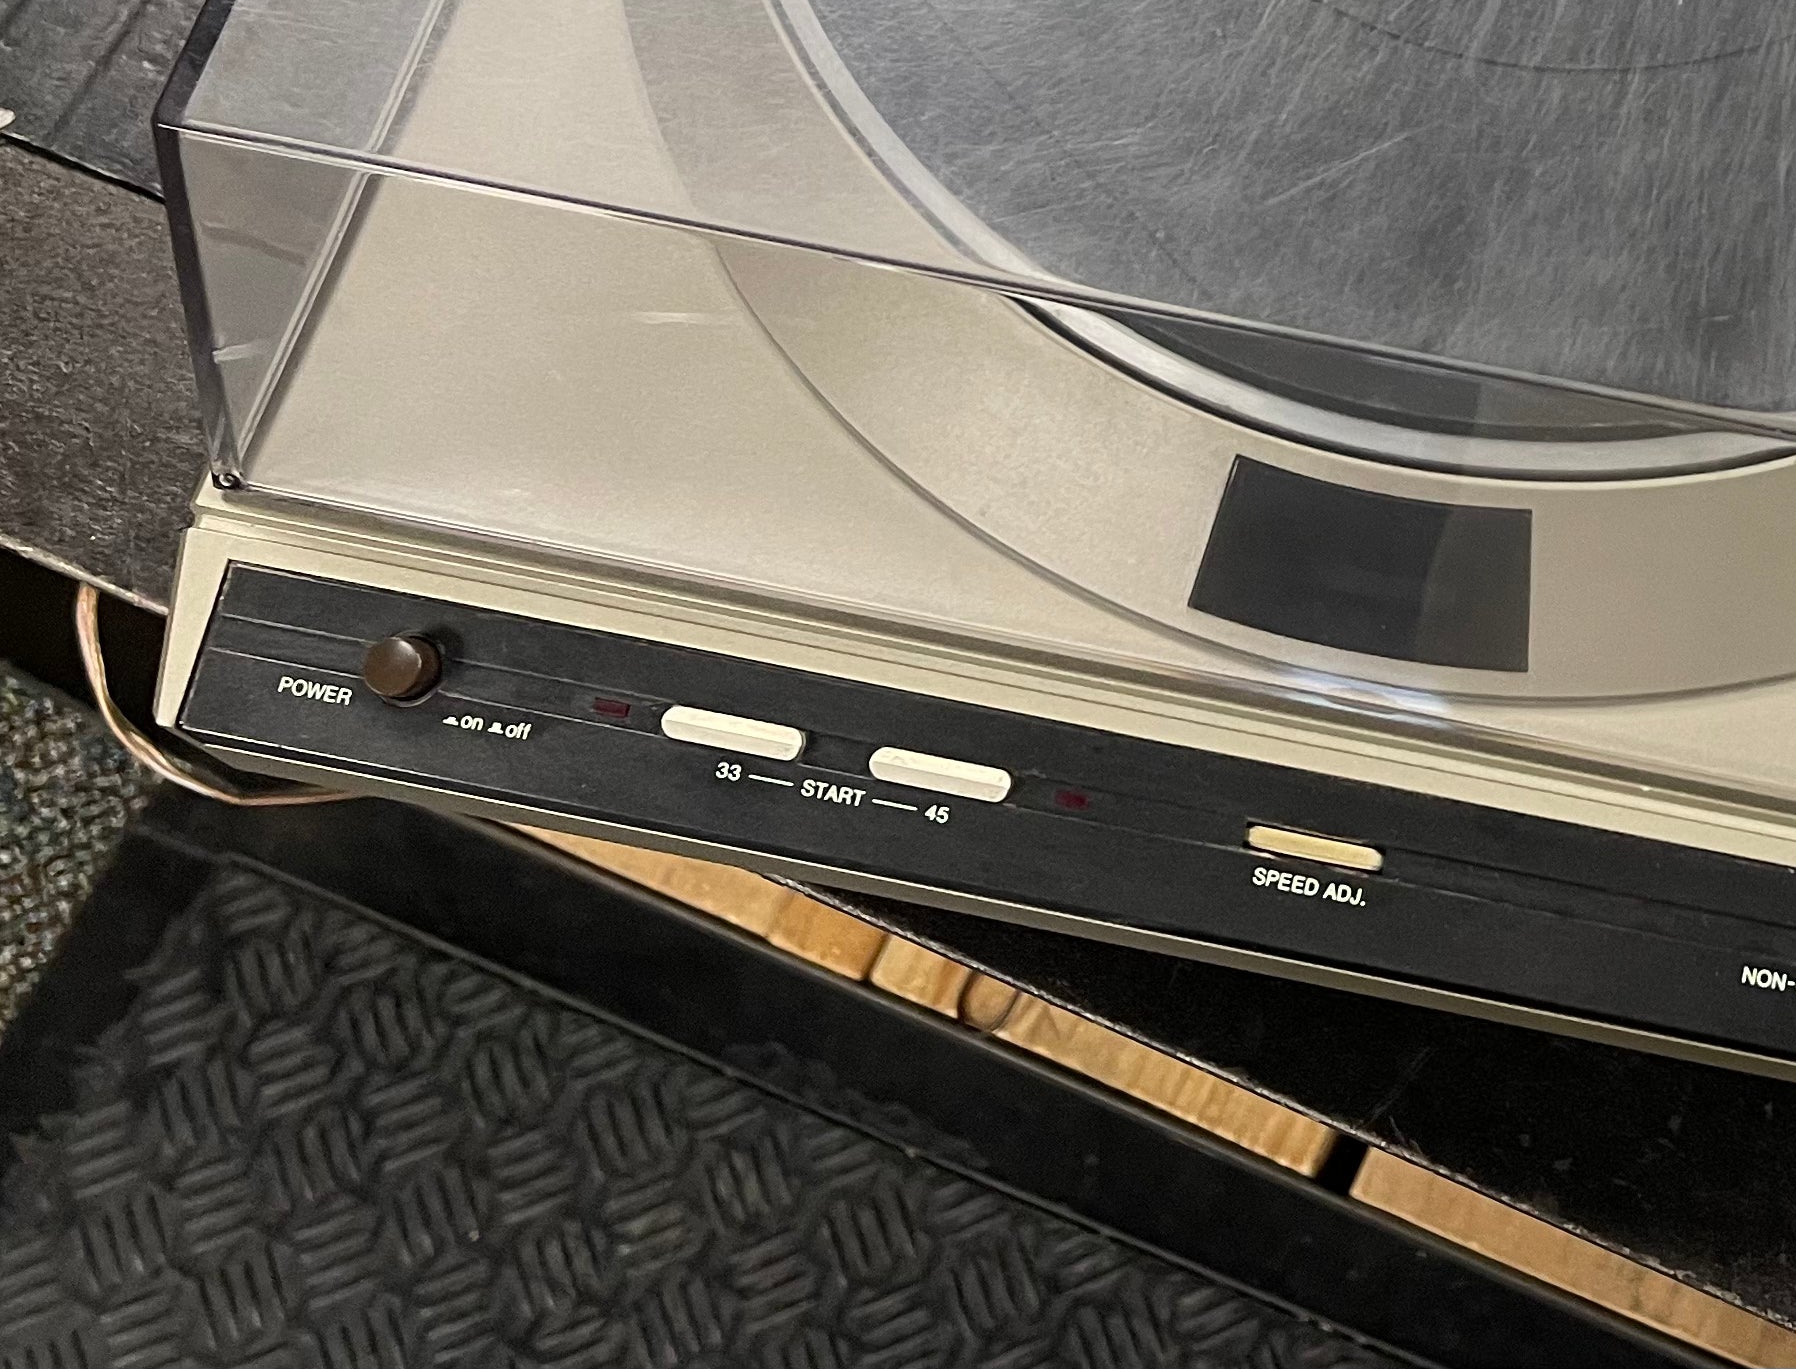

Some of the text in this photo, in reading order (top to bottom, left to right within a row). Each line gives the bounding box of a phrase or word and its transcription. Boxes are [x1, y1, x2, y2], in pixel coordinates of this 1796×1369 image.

[277, 676, 353, 706] POWER
[461, 715, 532, 740] on off
[715, 761, 950, 824] 33 START 45
[1252, 867, 1366, 907] SPEED ADJ.
